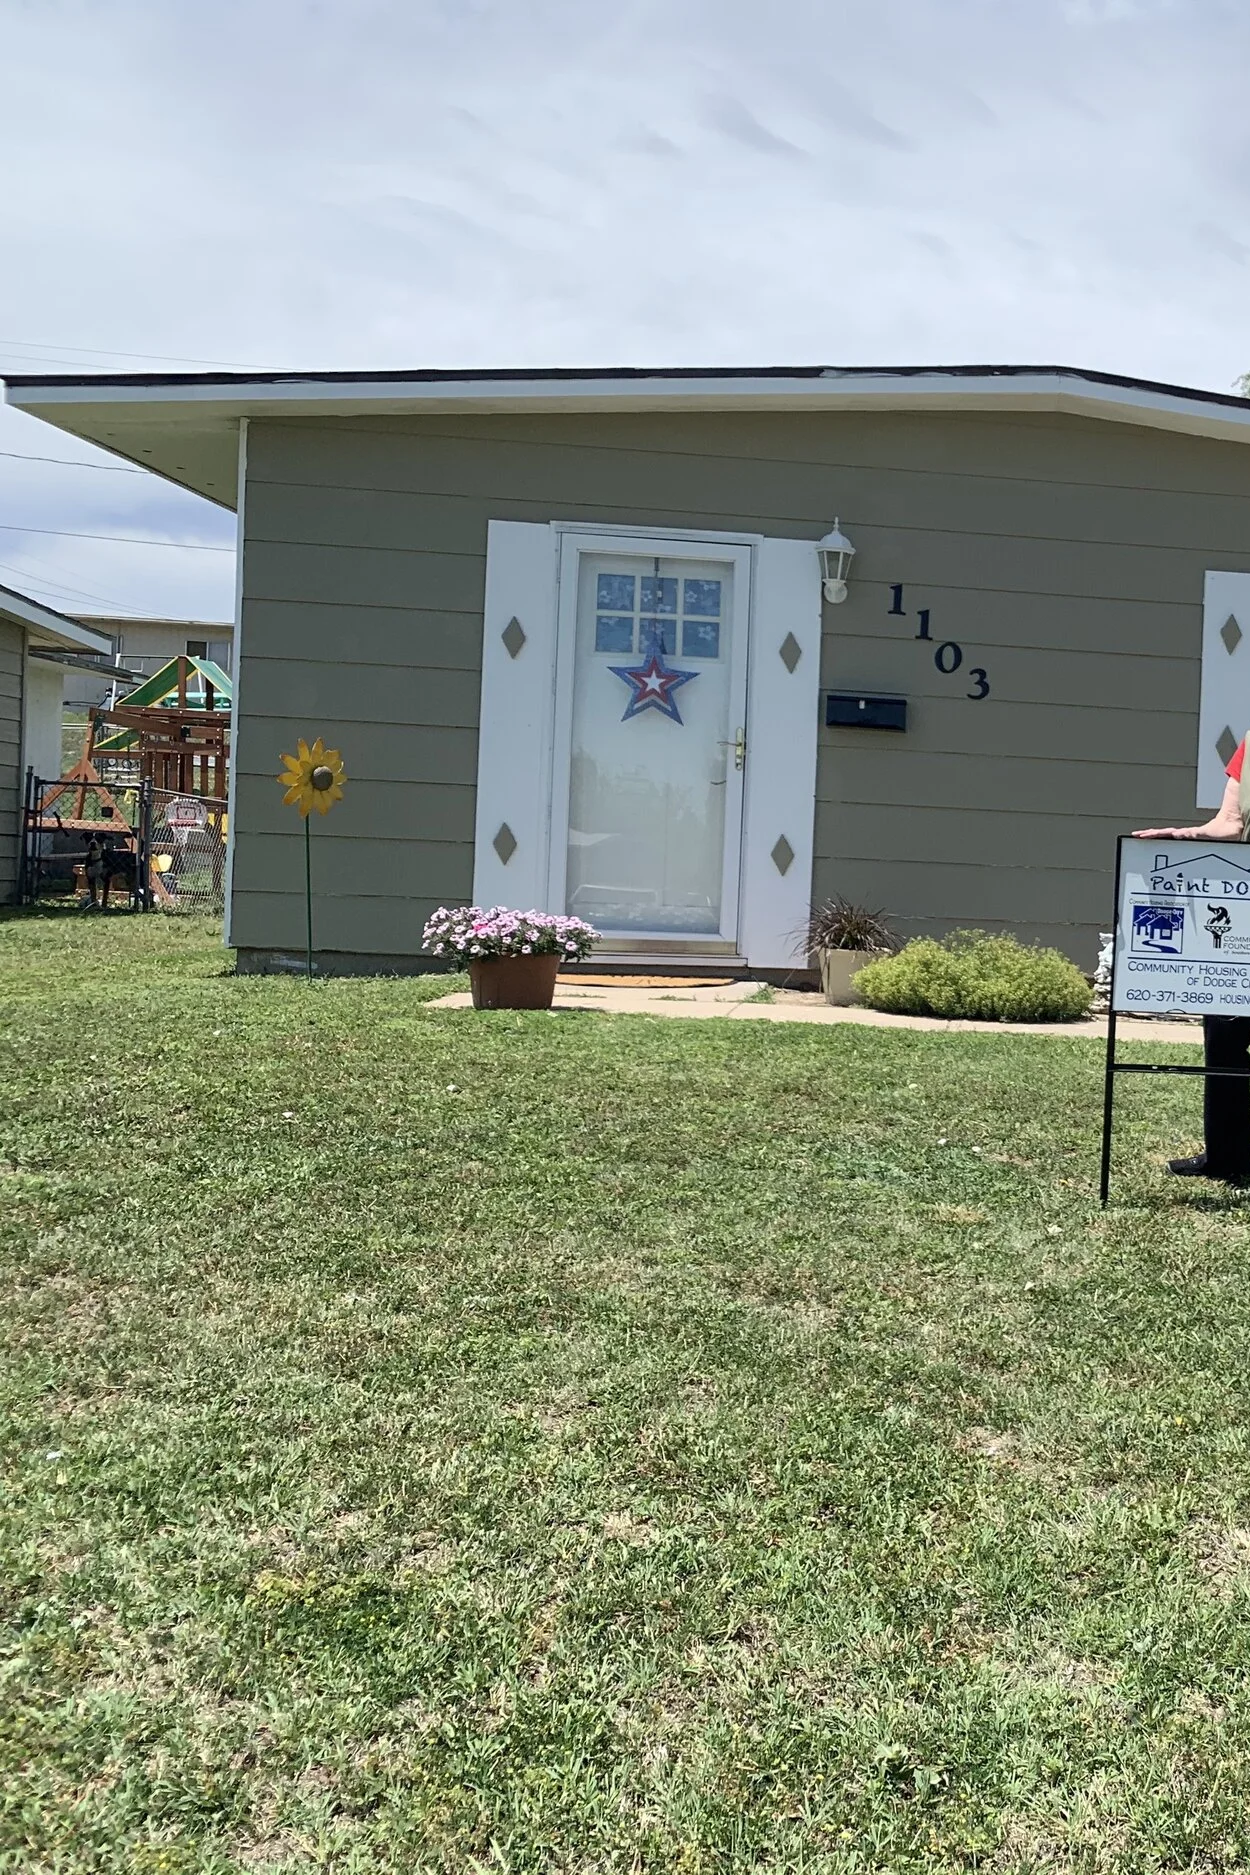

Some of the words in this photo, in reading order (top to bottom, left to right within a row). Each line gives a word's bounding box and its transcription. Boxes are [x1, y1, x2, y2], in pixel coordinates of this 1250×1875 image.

[887, 583, 990, 700] 1103
[1150, 873, 1210, 893] Paint
[1127, 960, 1194, 975] COMMUNITY
[1199, 964, 1248, 977] HOUSING
[1186, 977, 1200, 986] OF
[1203, 976, 1238, 988] DODGE
[1126, 988, 1214, 1004] 620-371-3869
